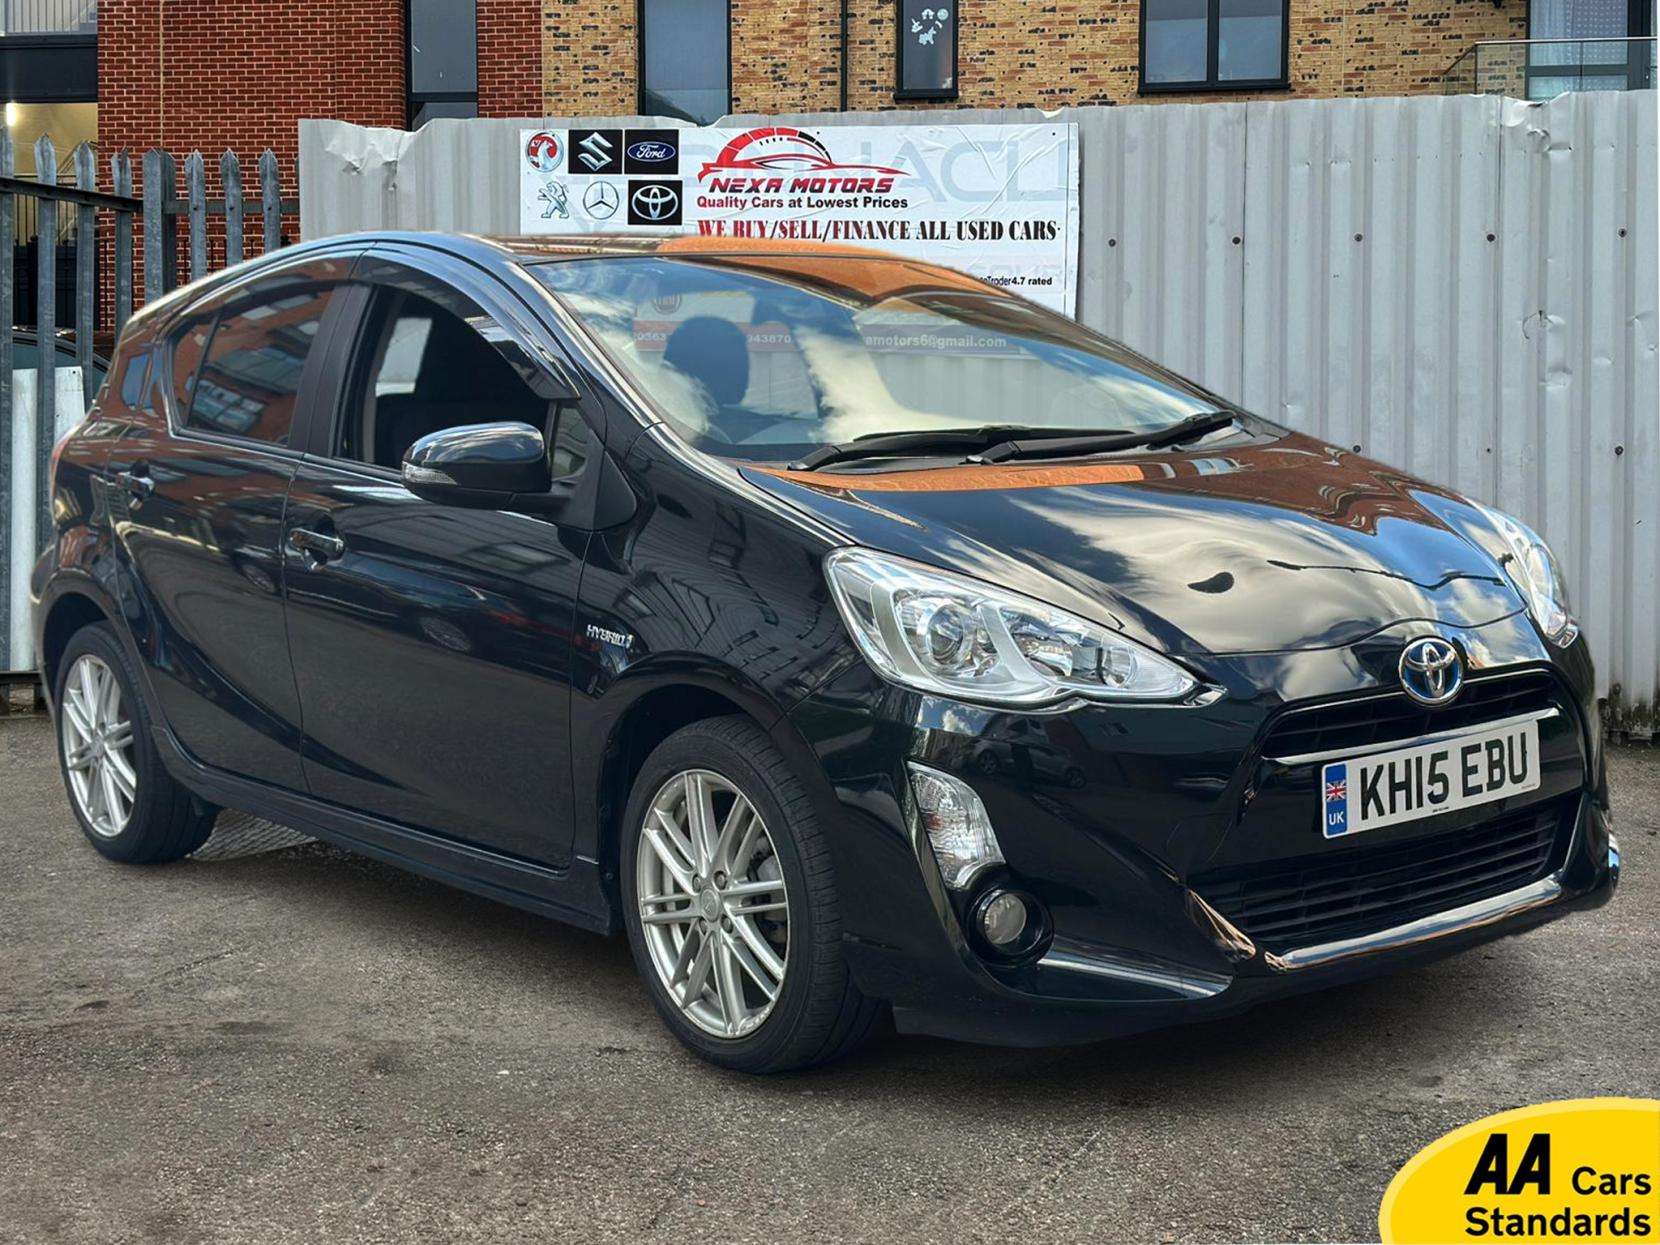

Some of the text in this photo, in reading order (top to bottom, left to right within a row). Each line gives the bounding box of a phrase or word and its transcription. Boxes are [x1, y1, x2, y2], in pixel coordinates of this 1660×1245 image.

[636, 144, 667, 159] Ford
[709, 177, 894, 194] NEXA MOTORS
[696, 196, 908, 210] Quality Cars at Lowest Prices
[697, 220, 727, 238] WE
[916, 220, 951, 240] ALL
[956, 220, 1004, 241] USED
[1008, 220, 1057, 241] CARS
[1028, 277, 1053, 286] rated
[586, 624, 626, 647] HYBRID
[1460, 732, 1528, 798] EBU
[1328, 811, 1344, 826] UK
